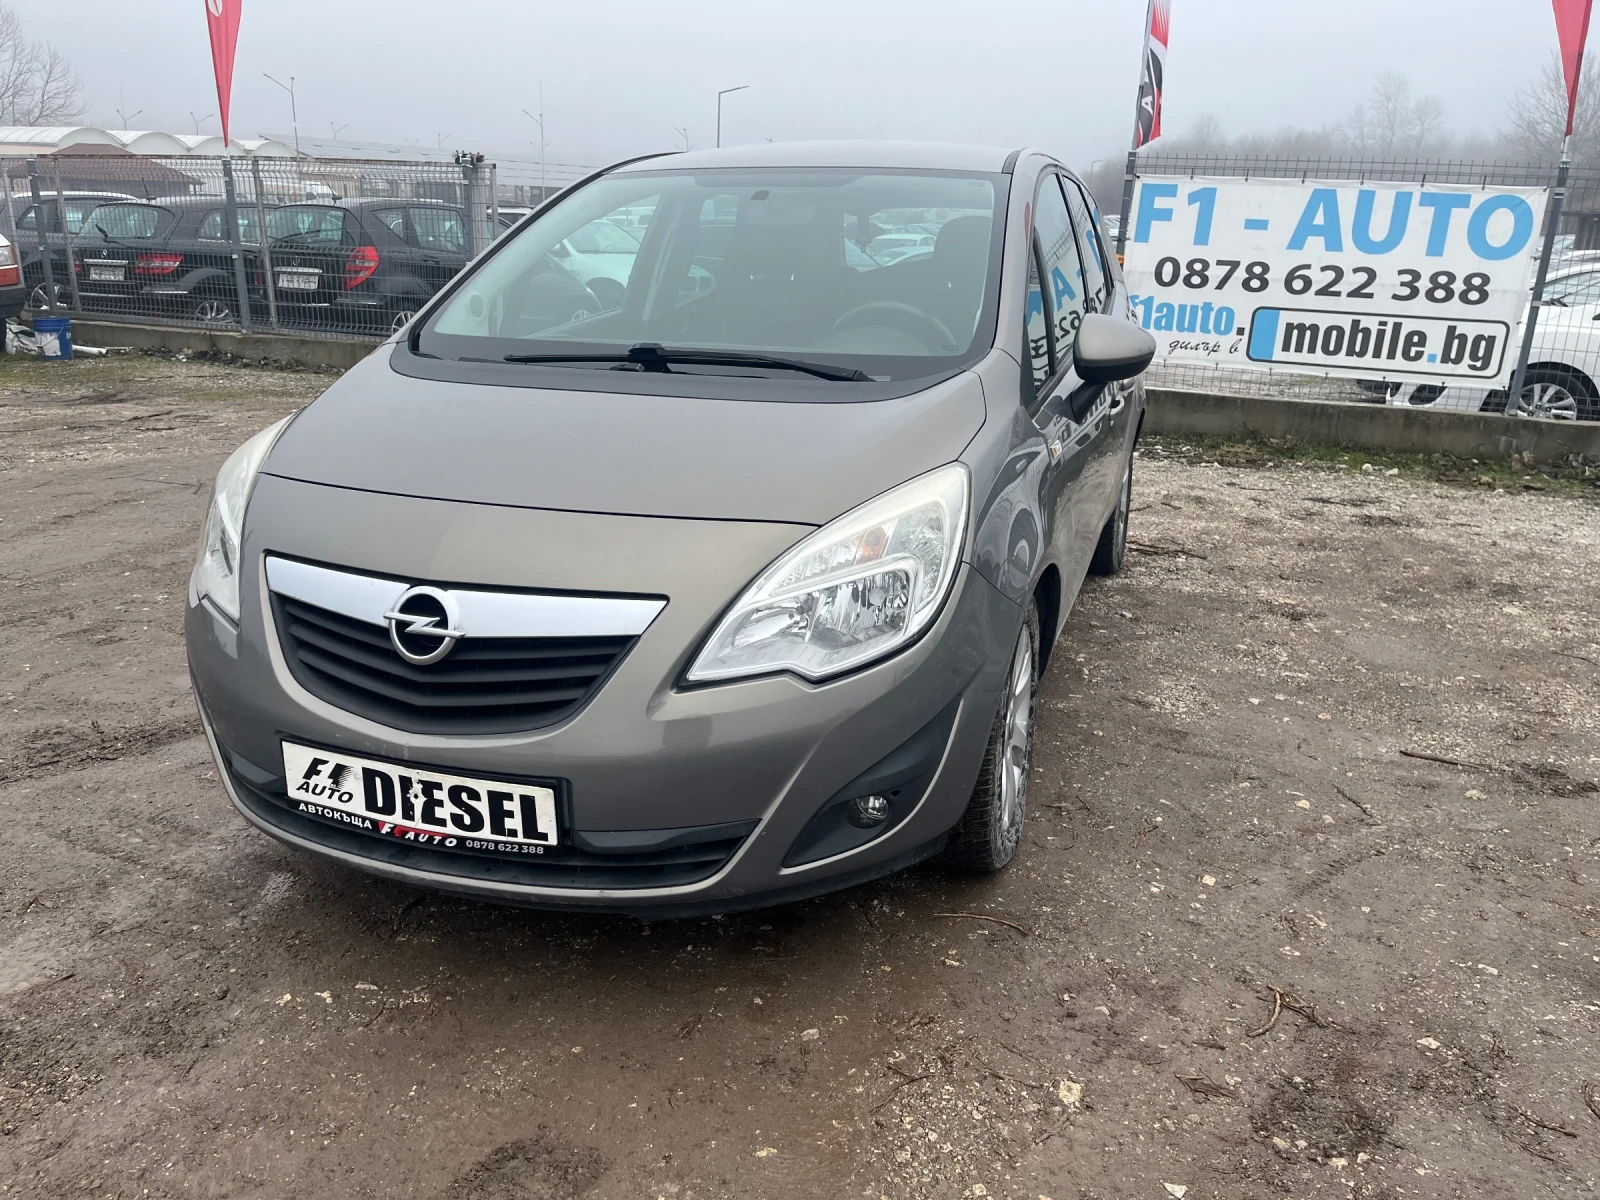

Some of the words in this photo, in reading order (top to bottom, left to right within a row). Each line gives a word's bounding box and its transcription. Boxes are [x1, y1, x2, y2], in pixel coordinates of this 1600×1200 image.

[1133, 182, 1218, 246] F1
[1286, 188, 1534, 261] AUTO
[1154, 256, 1271, 293] 0878
[1283, 263, 1377, 299] 622
[1391, 268, 1491, 306] 388
[1168, 340, 1221, 356] дилър
[1281, 318, 1497, 372] mobile.bg
[302, 757, 354, 790] F1
[295, 780, 354, 804] AUTO
[361, 766, 549, 843] DIESEL
[298, 802, 373, 830] АВТОКЪЩА
[404, 830, 457, 847] AUTO
[465, 839, 495, 850] 0878
[498, 843, 519, 852] 622
[521, 844, 544, 854] 388
